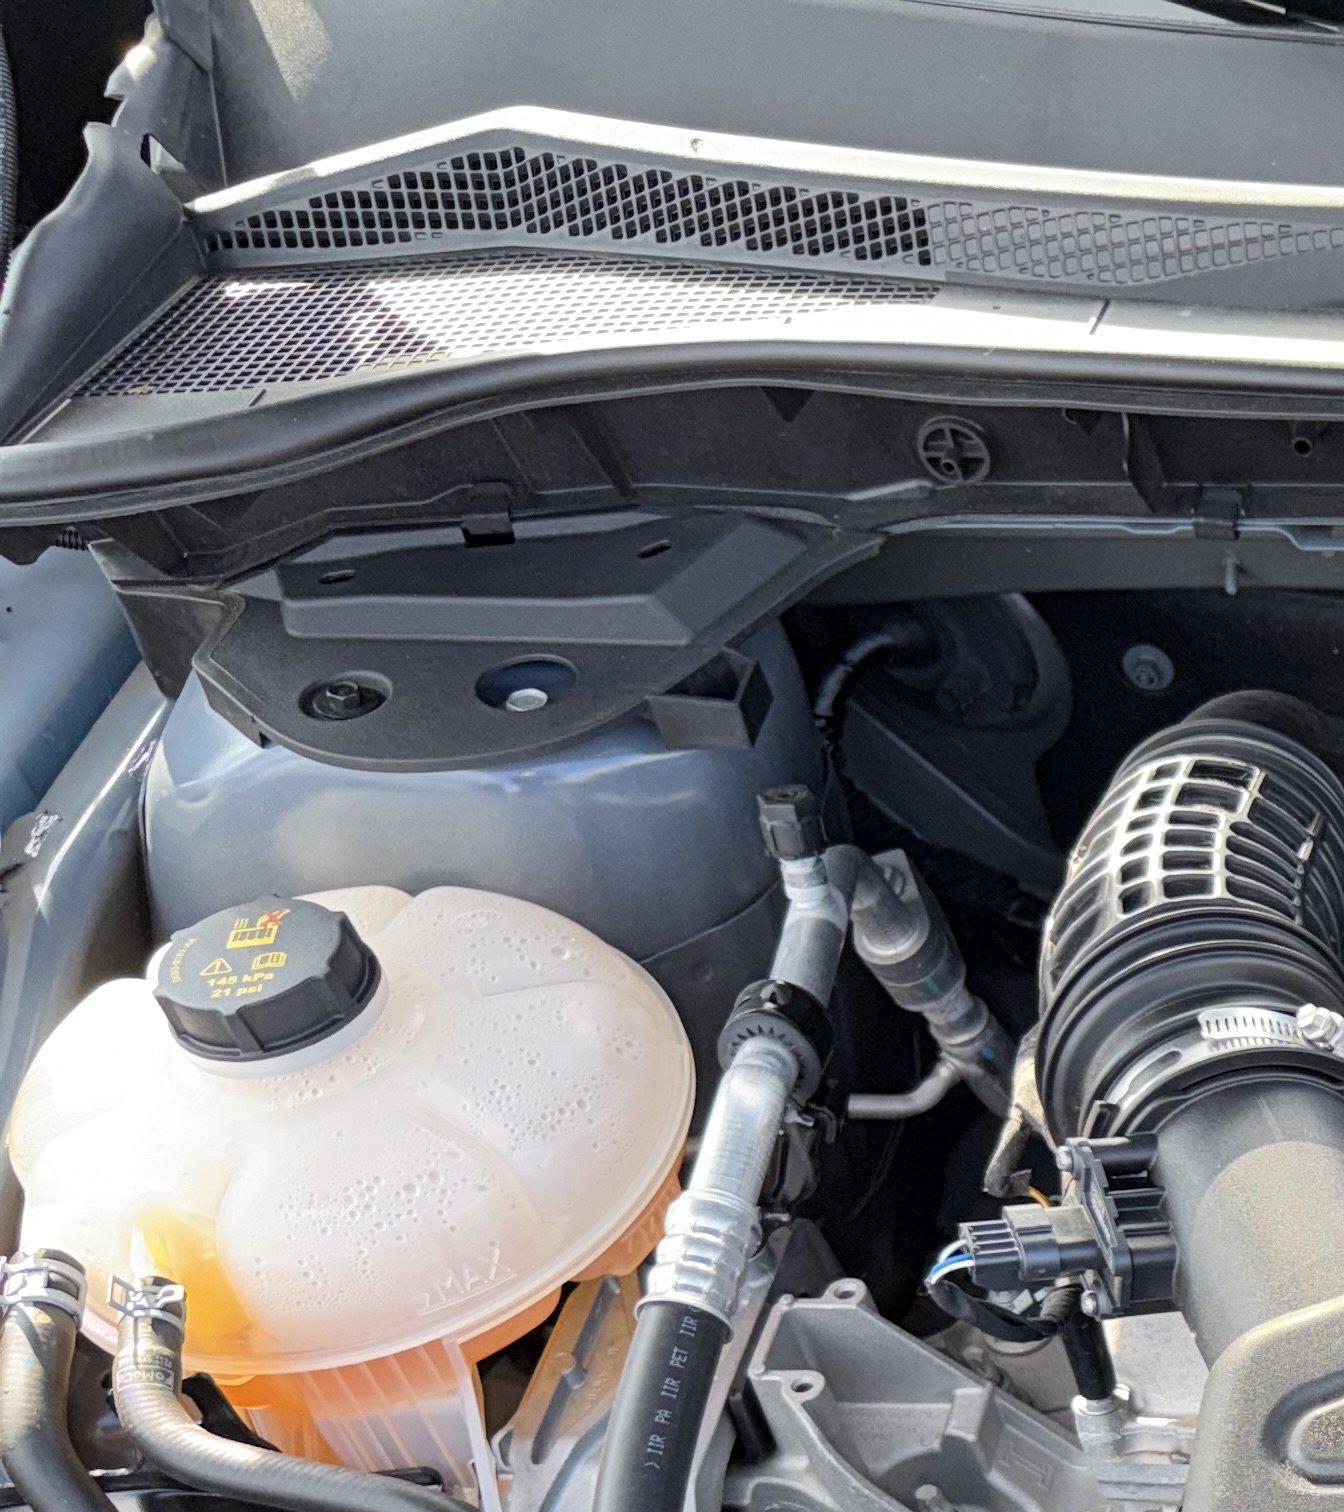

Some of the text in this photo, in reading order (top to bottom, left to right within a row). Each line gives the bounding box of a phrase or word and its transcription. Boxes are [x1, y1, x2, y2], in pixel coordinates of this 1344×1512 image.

[206, 971, 275, 987] 145 kPa
[210, 983, 264, 999] 21 psi
[653, 1408, 674, 1425] PA
[669, 1346, 690, 1370] PET
